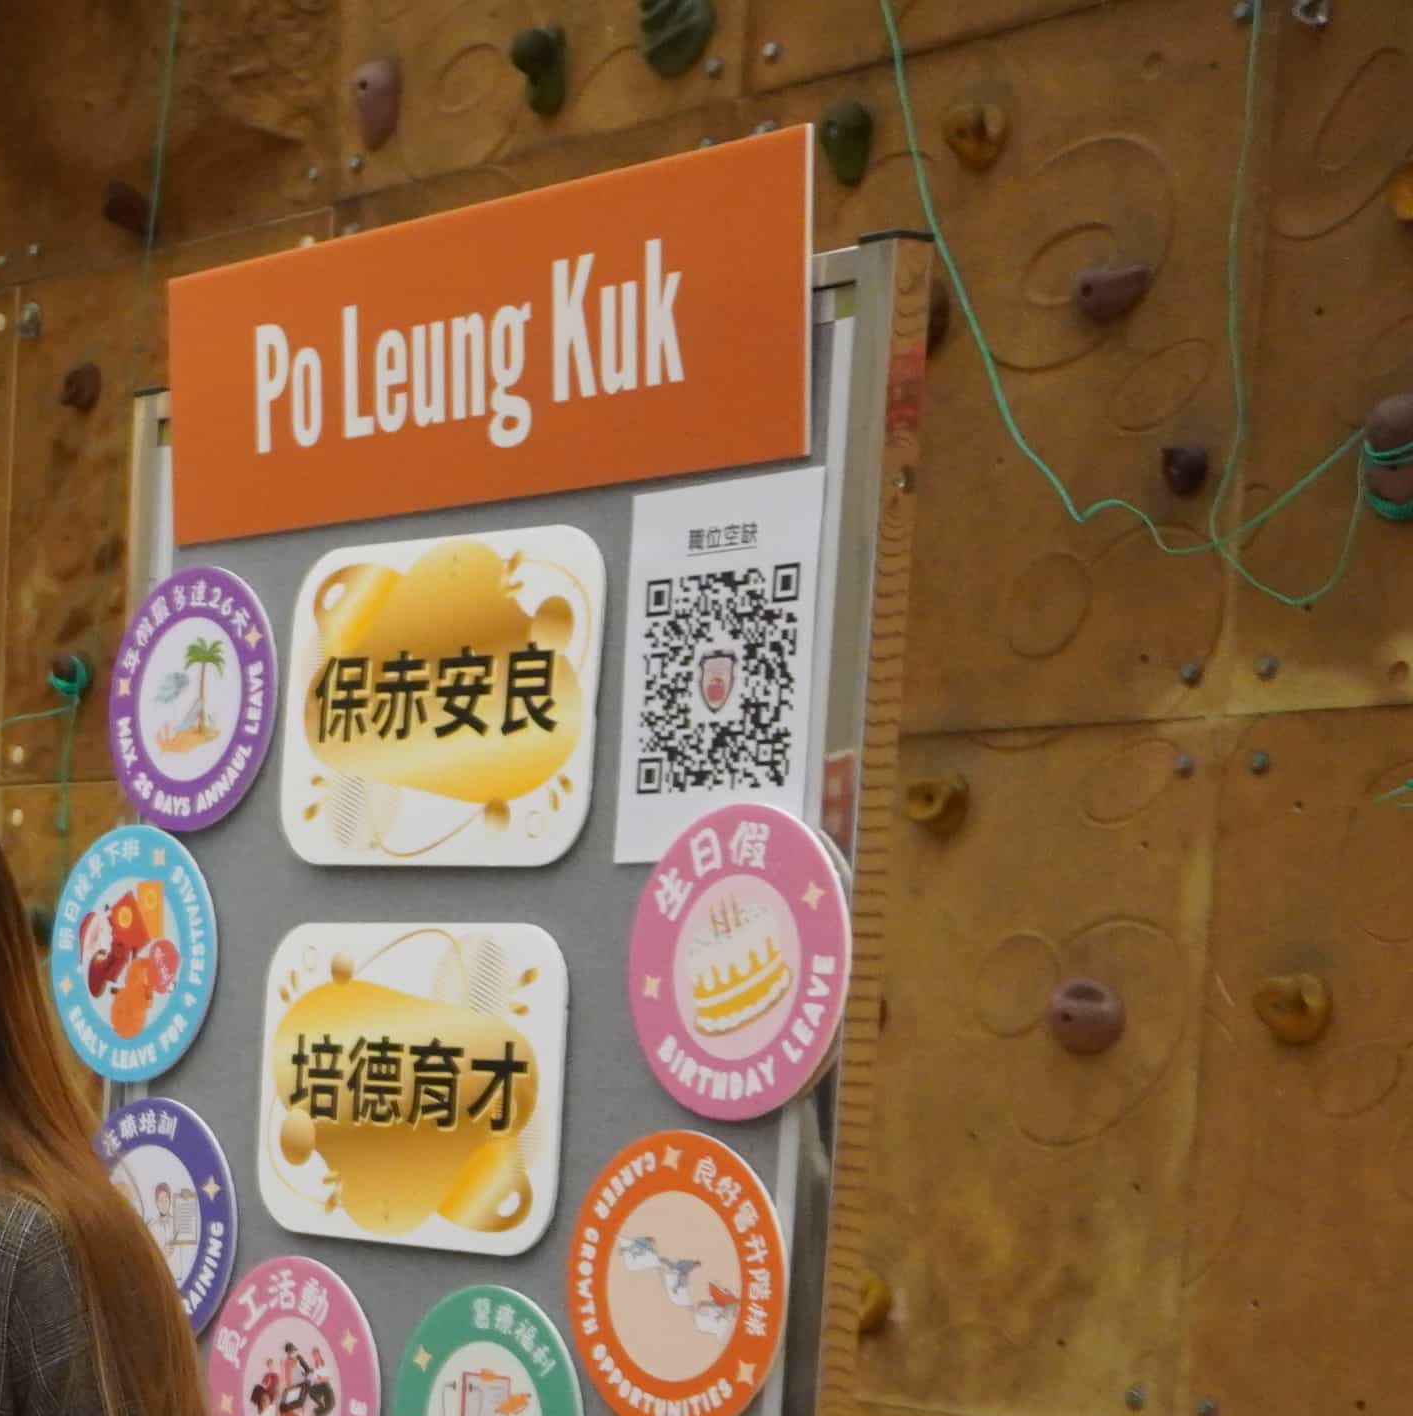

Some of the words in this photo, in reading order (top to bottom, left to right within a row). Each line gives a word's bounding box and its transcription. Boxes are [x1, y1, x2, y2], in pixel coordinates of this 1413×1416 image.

[254, 323, 323, 454] Po
[342, 301, 533, 450] Leung
[551, 238, 687, 403] Kuk
[133, 771, 154, 799] 26
[153, 791, 190, 817] DAYS
[245, 661, 264, 735] LEAVE
[315, 642, 558, 743] 保赤安良
[654, 820, 770, 922] 生日假
[171, 865, 205, 985] FESTIVALS
[69, 1005, 108, 1058] EARLY
[111, 1044, 157, 1069] LEAVE
[160, 1013, 188, 1050] FOR
[656, 1034, 775, 1101] BIRTHDAY
[781, 954, 835, 1064] LEAVE
[290, 1035, 529, 1133] 培德育才
[594, 1151, 657, 1220] CAREER
[217, 1269, 330, 1369] 員工活動
[577, 1226, 600, 1336] GROWTH
